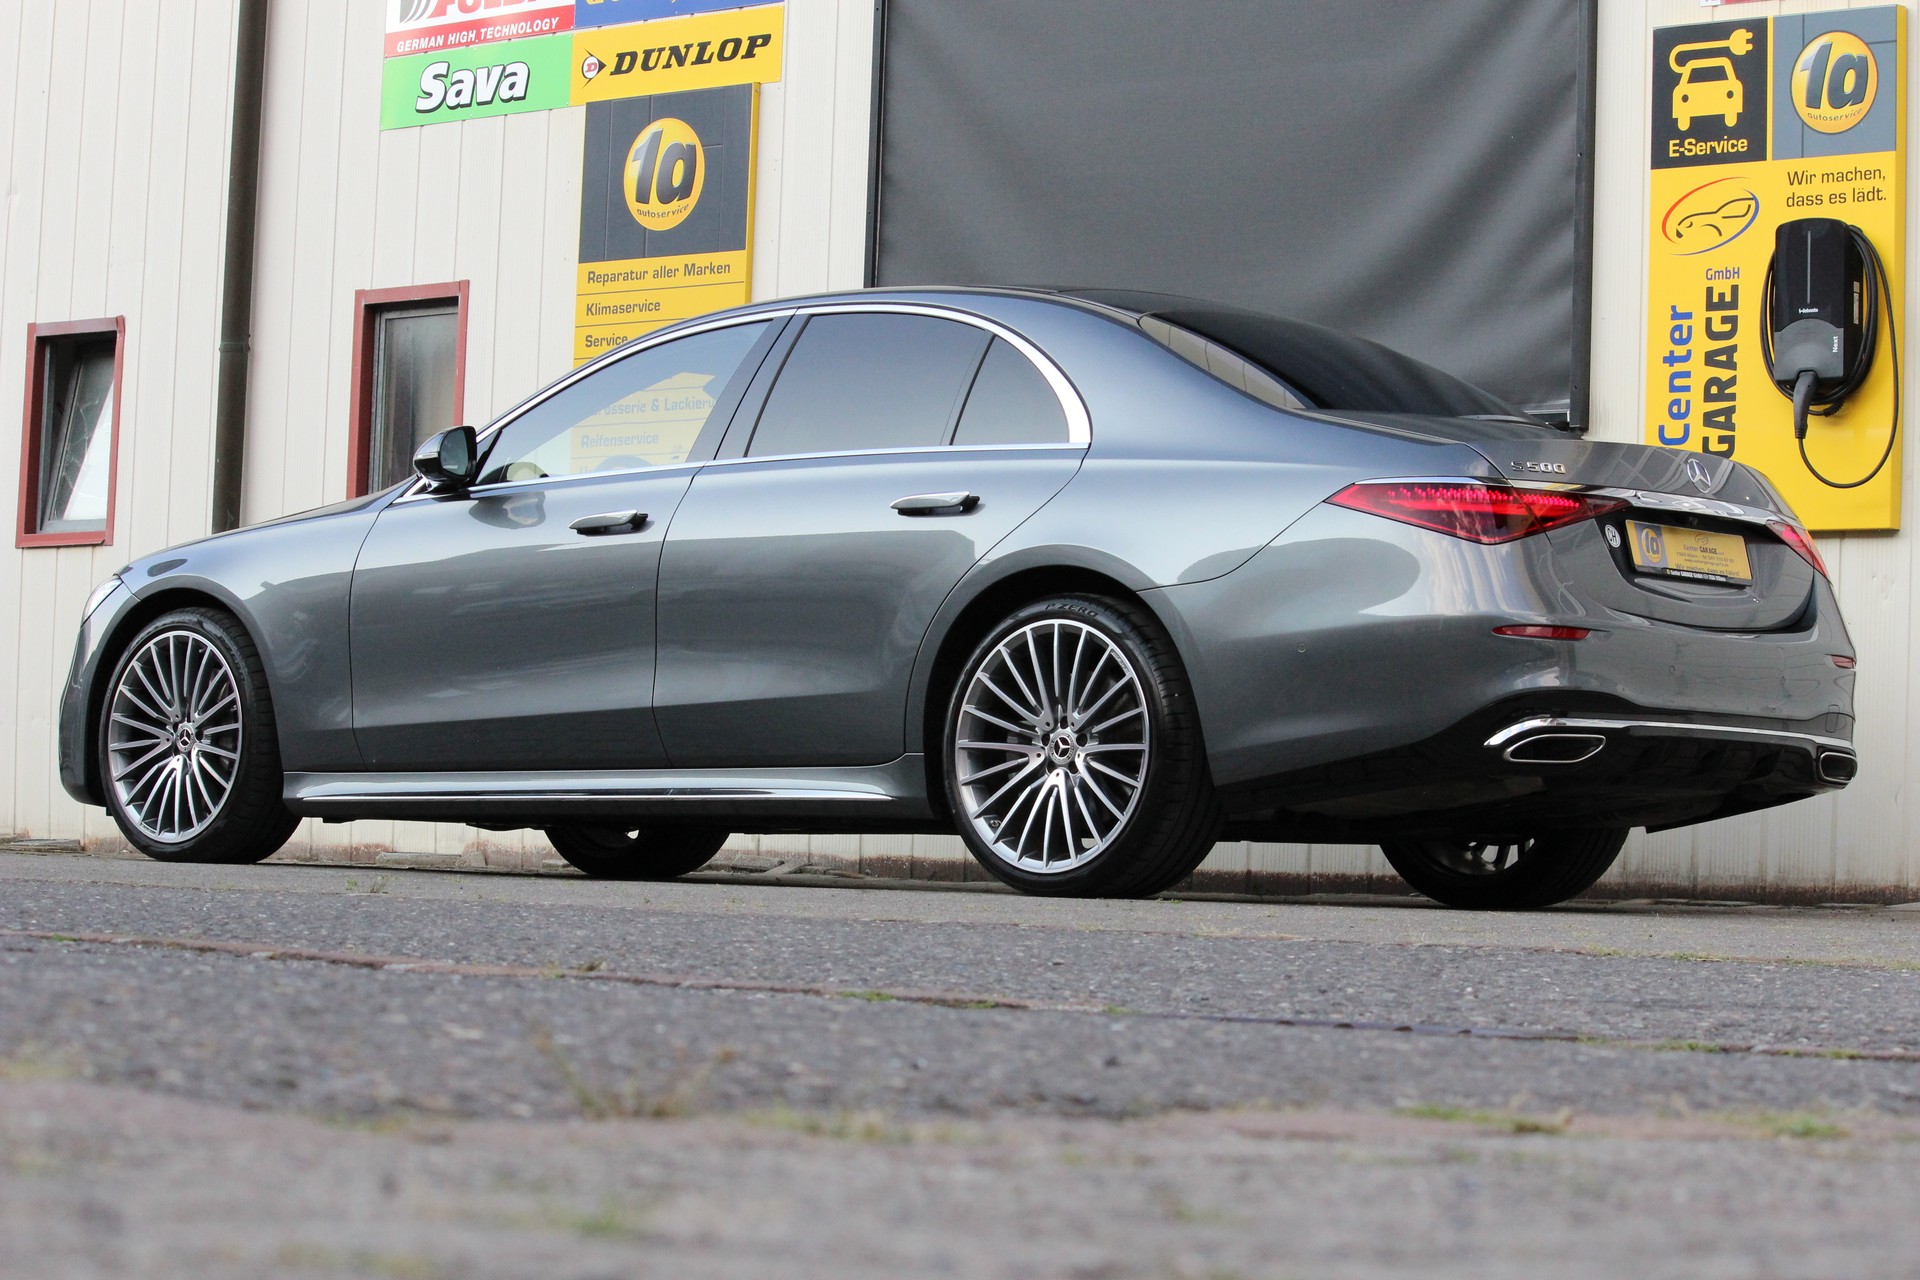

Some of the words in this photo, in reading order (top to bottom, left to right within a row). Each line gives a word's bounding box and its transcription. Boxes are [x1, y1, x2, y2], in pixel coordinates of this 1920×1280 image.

[397, 35, 445, 53] GERMAN
[480, 17, 559, 40] TECHNOLOGY
[609, 33, 772, 76] DUNLOP
[1800, 41, 1869, 110] 1a
[415, 60, 530, 114] Sava
[1807, 107, 1863, 121] autoservice
[1668, 136, 1748, 158] E-Service
[632, 128, 697, 205] 1a
[1787, 171, 1817, 186] Wir
[1821, 167, 1886, 184] machen,
[1786, 192, 1824, 208] dass
[1828, 190, 1847, 204] es
[1852, 187, 1887, 202] lädt.
[636, 204, 689, 219] autoservice
[587, 269, 649, 287] Reparatur
[652, 265, 680, 280] aller
[683, 262, 731, 277] Marken
[1705, 266, 1741, 281] GmbH
[586, 299, 661, 317] Klimaservice
[585, 333, 628, 348] Service
[1658, 305, 1693, 446] Center
[1702, 284, 1739, 459] GARAGE
[650, 398, 660, 412] &
[581, 432, 659, 449] Reifenservice
[1510, 461, 1525, 471] S
[1526, 461, 1566, 474] 500
[1606, 527, 1619, 544] CH
[1044, 603, 1055, 611] P
[1059, 604, 1099, 618] ZERO
